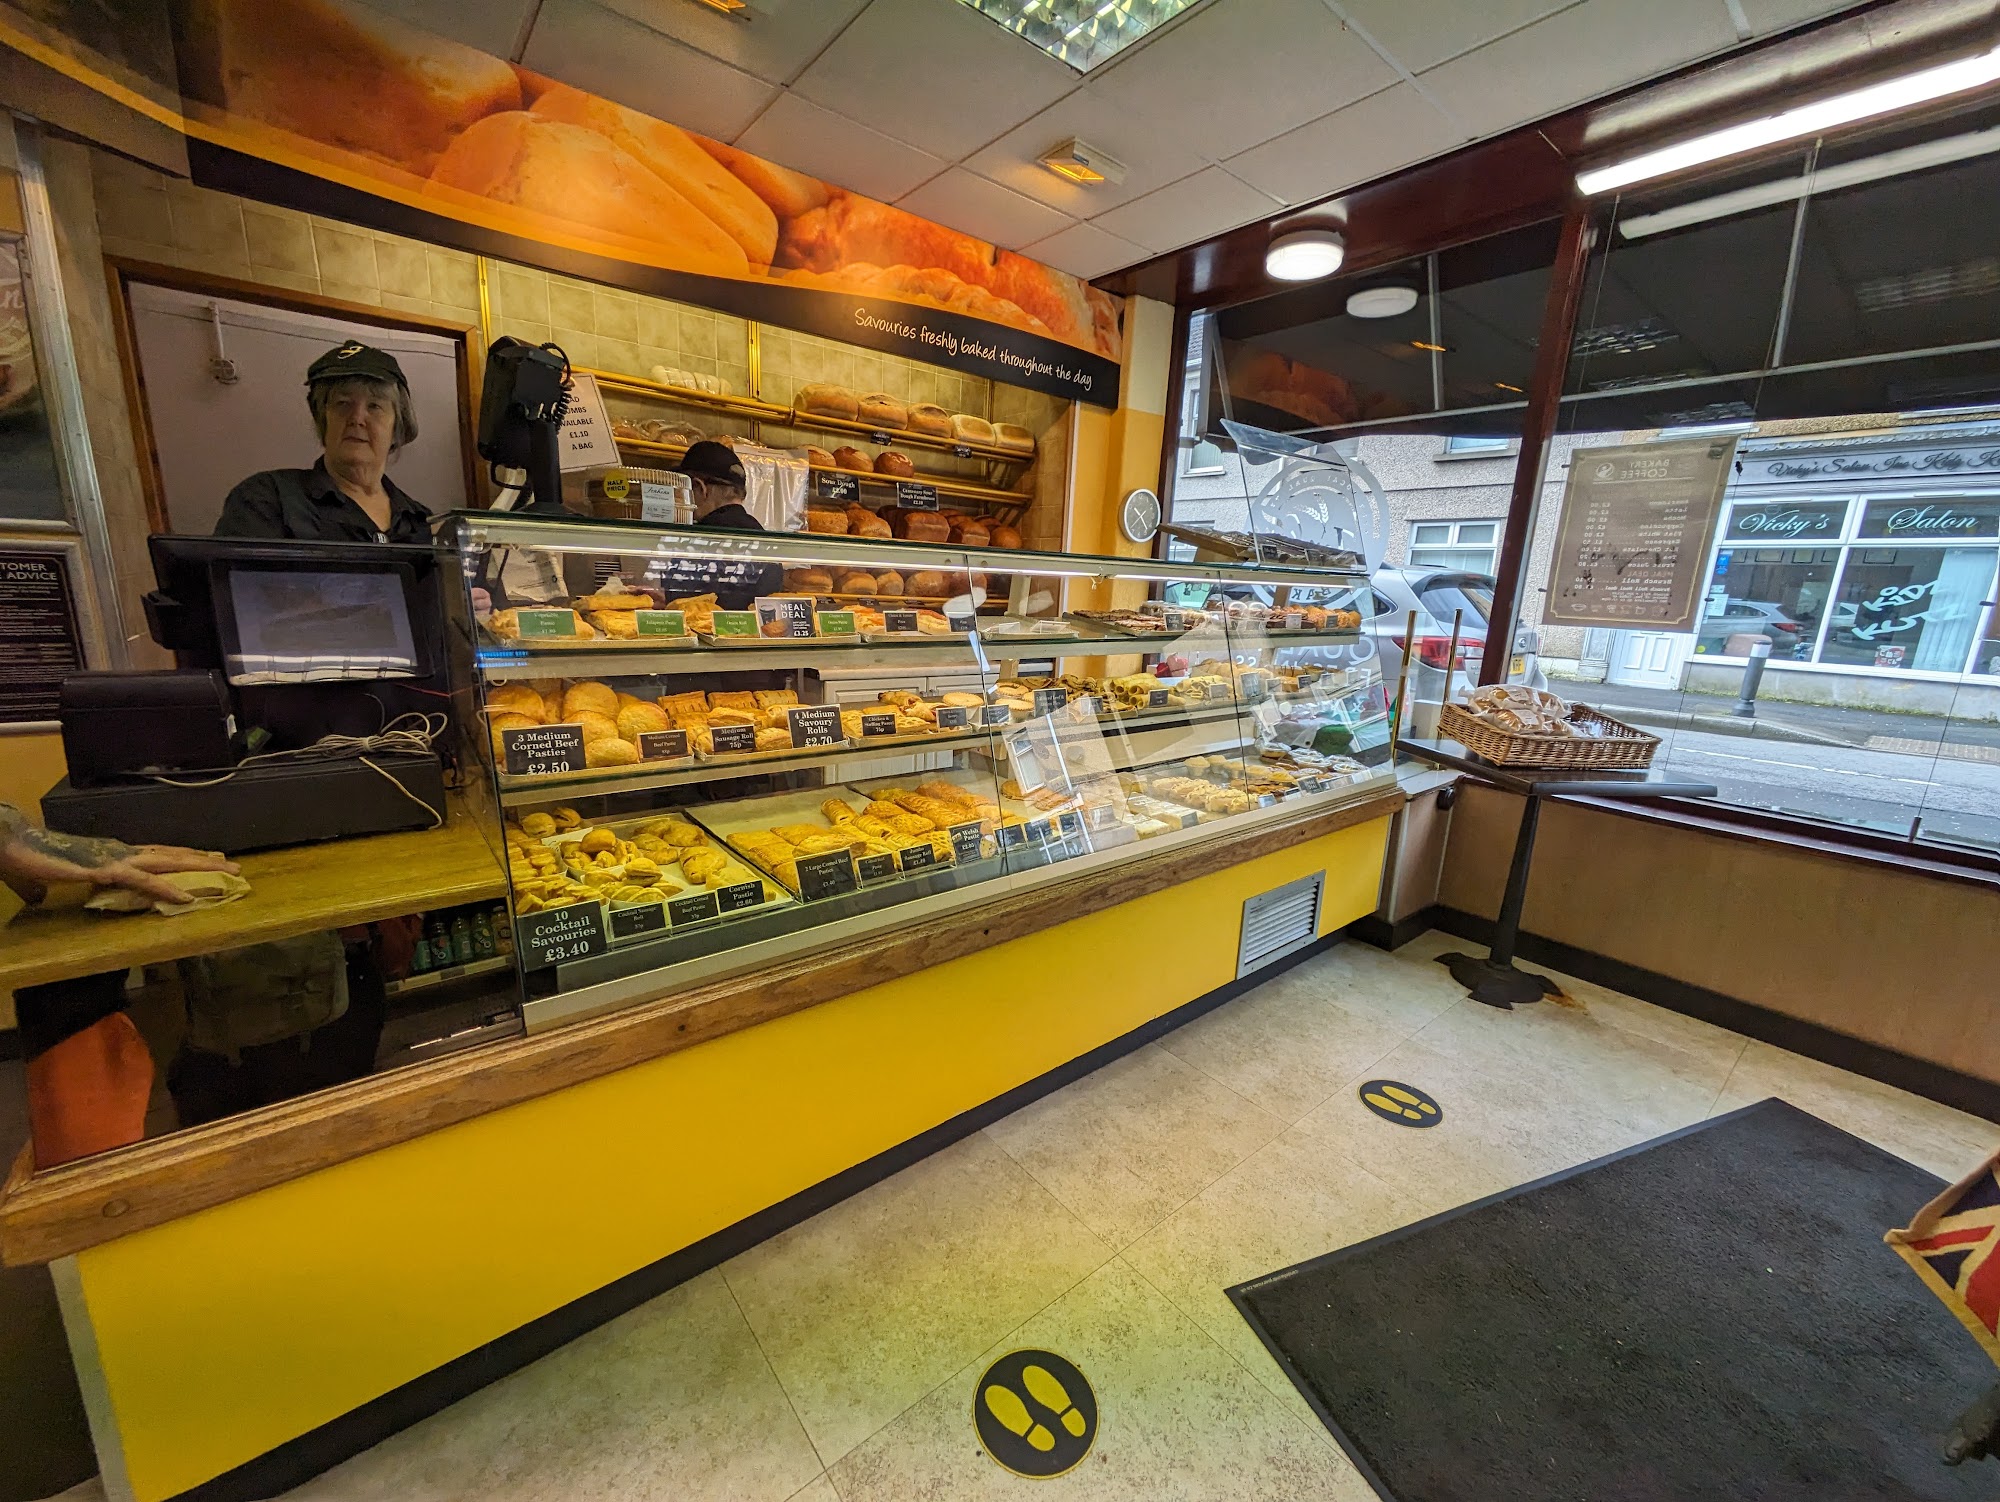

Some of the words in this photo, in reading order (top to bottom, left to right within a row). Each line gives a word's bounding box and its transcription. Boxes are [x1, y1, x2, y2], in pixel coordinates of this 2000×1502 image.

[854, 308, 916, 339] Savouries
[920, 325, 958, 356] freshly
[960, 337, 996, 361] baked
[1000, 348, 1053, 376] throughout
[1056, 364, 1072, 380] the
[1074, 368, 1092, 391] day
[569, 430, 588, 438] £1.10
[1768, 461, 1819, 478] Vicky's
[1823, 458, 1870, 474] Salon
[1739, 510, 1830, 538] Vicky's
[1888, 505, 1978, 534] Salon
[6, 572, 57, 580] ADVICE
[794, 712, 801, 720] 4
[802, 710, 836, 719] Medium
[798, 718, 833, 728] Savoury
[806, 726, 828, 734] Rolls
[526, 732, 572, 742] Medium
[804, 736, 833, 747] £2.70
[512, 740, 552, 752] Corned
[554, 738, 580, 750] Beef
[527, 748, 566, 760] Pasties
[526, 761, 570, 775] £2.50
[962, 828, 979, 836] Welsh
[822, 860, 838, 868] Corned
[729, 882, 756, 893] Cornish
[733, 891, 754, 900] Pastie
[638, 906, 657, 914] Sausage
[554, 911, 568, 922] 10
[535, 916, 591, 936] Cocktail
[531, 926, 597, 949] Savouries
[544, 940, 590, 963] £3.40
